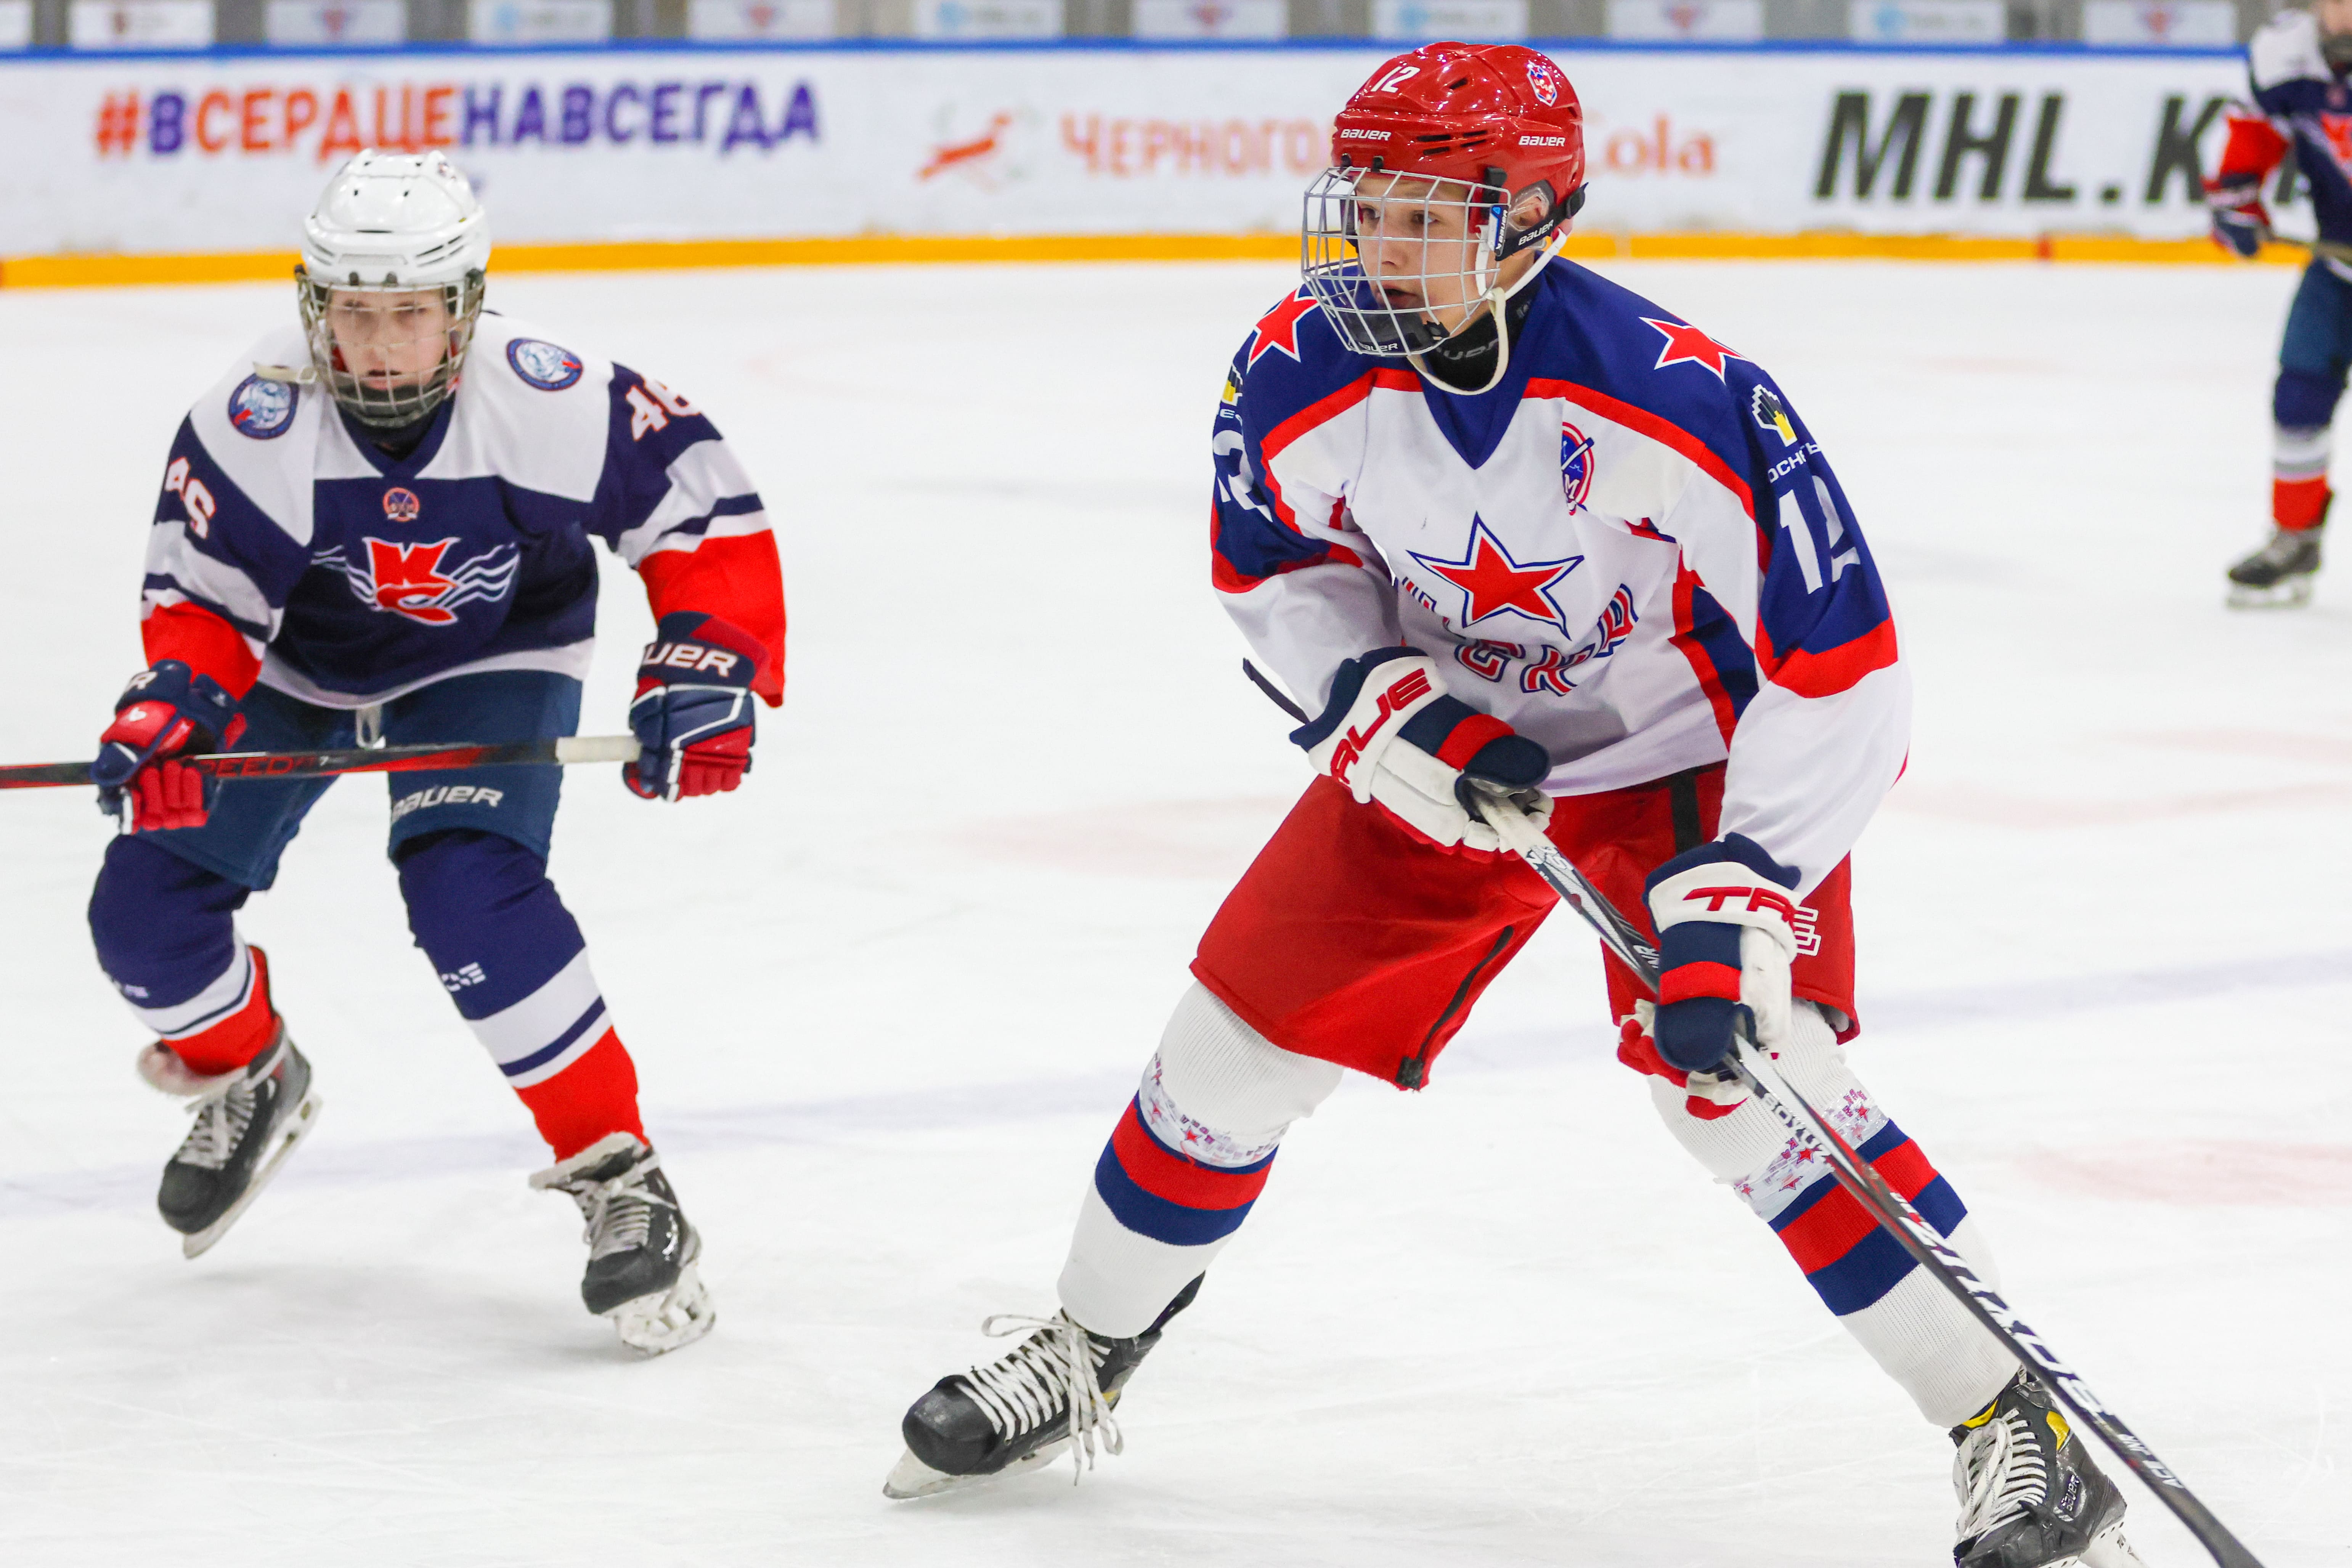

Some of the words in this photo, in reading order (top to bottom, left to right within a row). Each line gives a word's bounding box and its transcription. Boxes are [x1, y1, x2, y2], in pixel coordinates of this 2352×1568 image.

[1372, 66, 1421, 93] 12
[1060, 110, 1331, 177] ЧЕРНОГО
[1340, 129, 1392, 141] BAUER
[1518, 135, 1566, 147] BAUER
[1816, 91, 2299, 204] MHL.K
[1517, 219, 1554, 246] BAUER
[643, 642, 738, 678] UER
